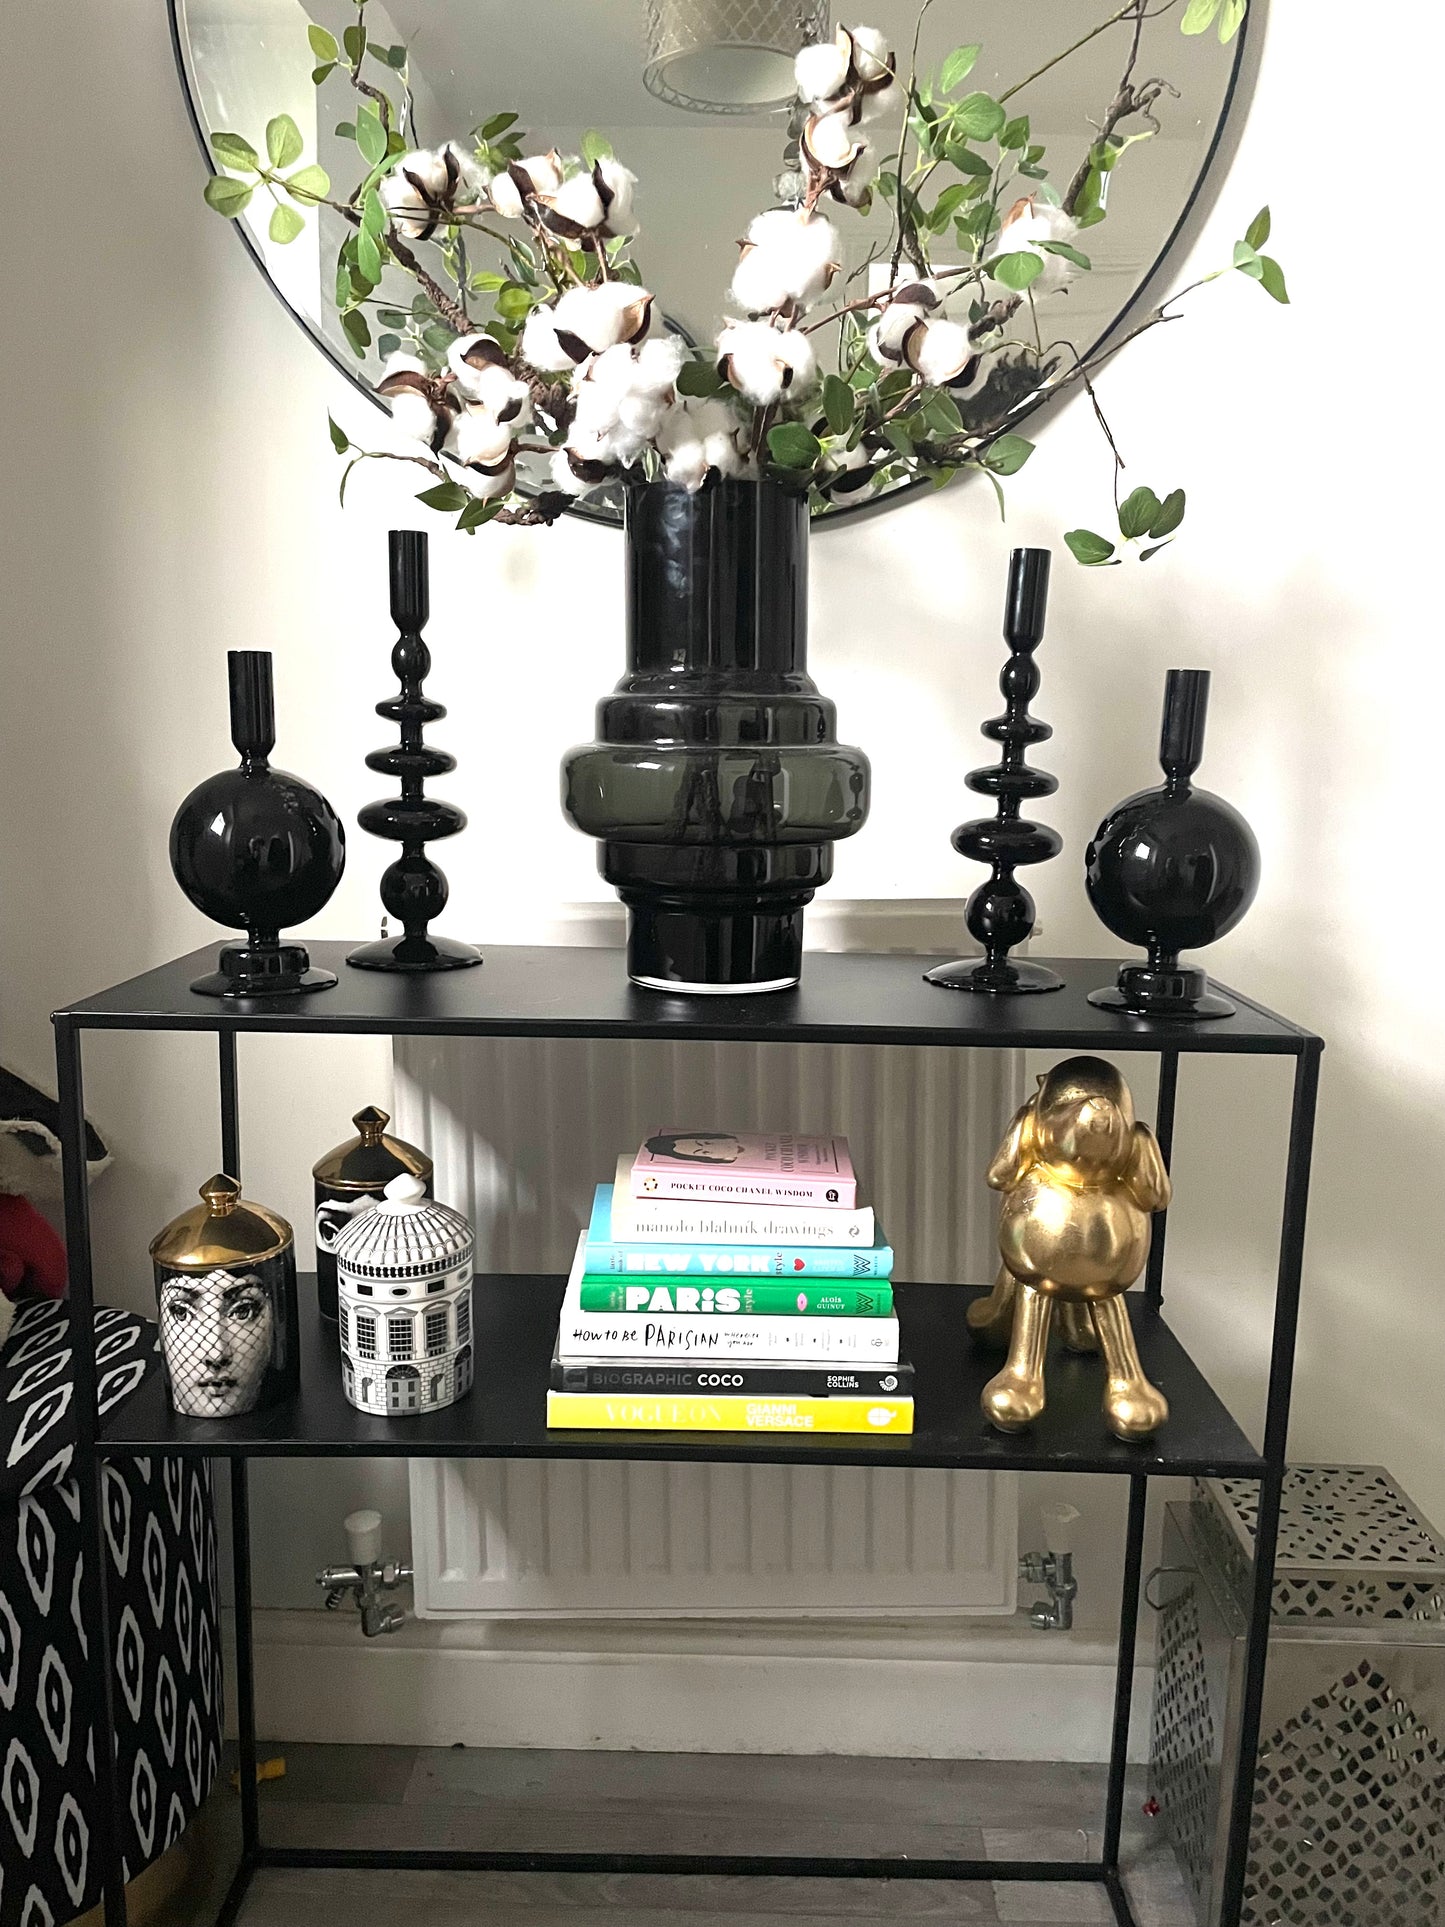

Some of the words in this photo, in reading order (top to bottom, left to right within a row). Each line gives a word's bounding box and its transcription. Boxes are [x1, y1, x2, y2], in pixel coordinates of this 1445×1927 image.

[671, 1182, 706, 1192] POCKET
[709, 1184, 733, 1193] COCO
[735, 1186, 773, 1196] CHANEL
[775, 1189, 813, 1198] WISDOM
[636, 1220, 694, 1233] manolo
[700, 1220, 758, 1234] blahnik
[764, 1221, 834, 1239] drawings
[626, 1253, 692, 1271] NEW
[698, 1254, 771, 1272] YORK
[774, 1252, 783, 1275] style
[744, 1288, 755, 1312] style
[645, 1323, 719, 1350] PARISIAN
[593, 1373, 692, 1386] BIOGRAPHIC
[697, 1374, 744, 1387] COCO
[827, 1375, 855, 1383] SOPHIE
[606, 1402, 687, 1423] VOGUE
[690, 1403, 722, 1422] ON
[746, 1403, 797, 1415] GIANNI
[746, 1415, 814, 1428] VERSACE
